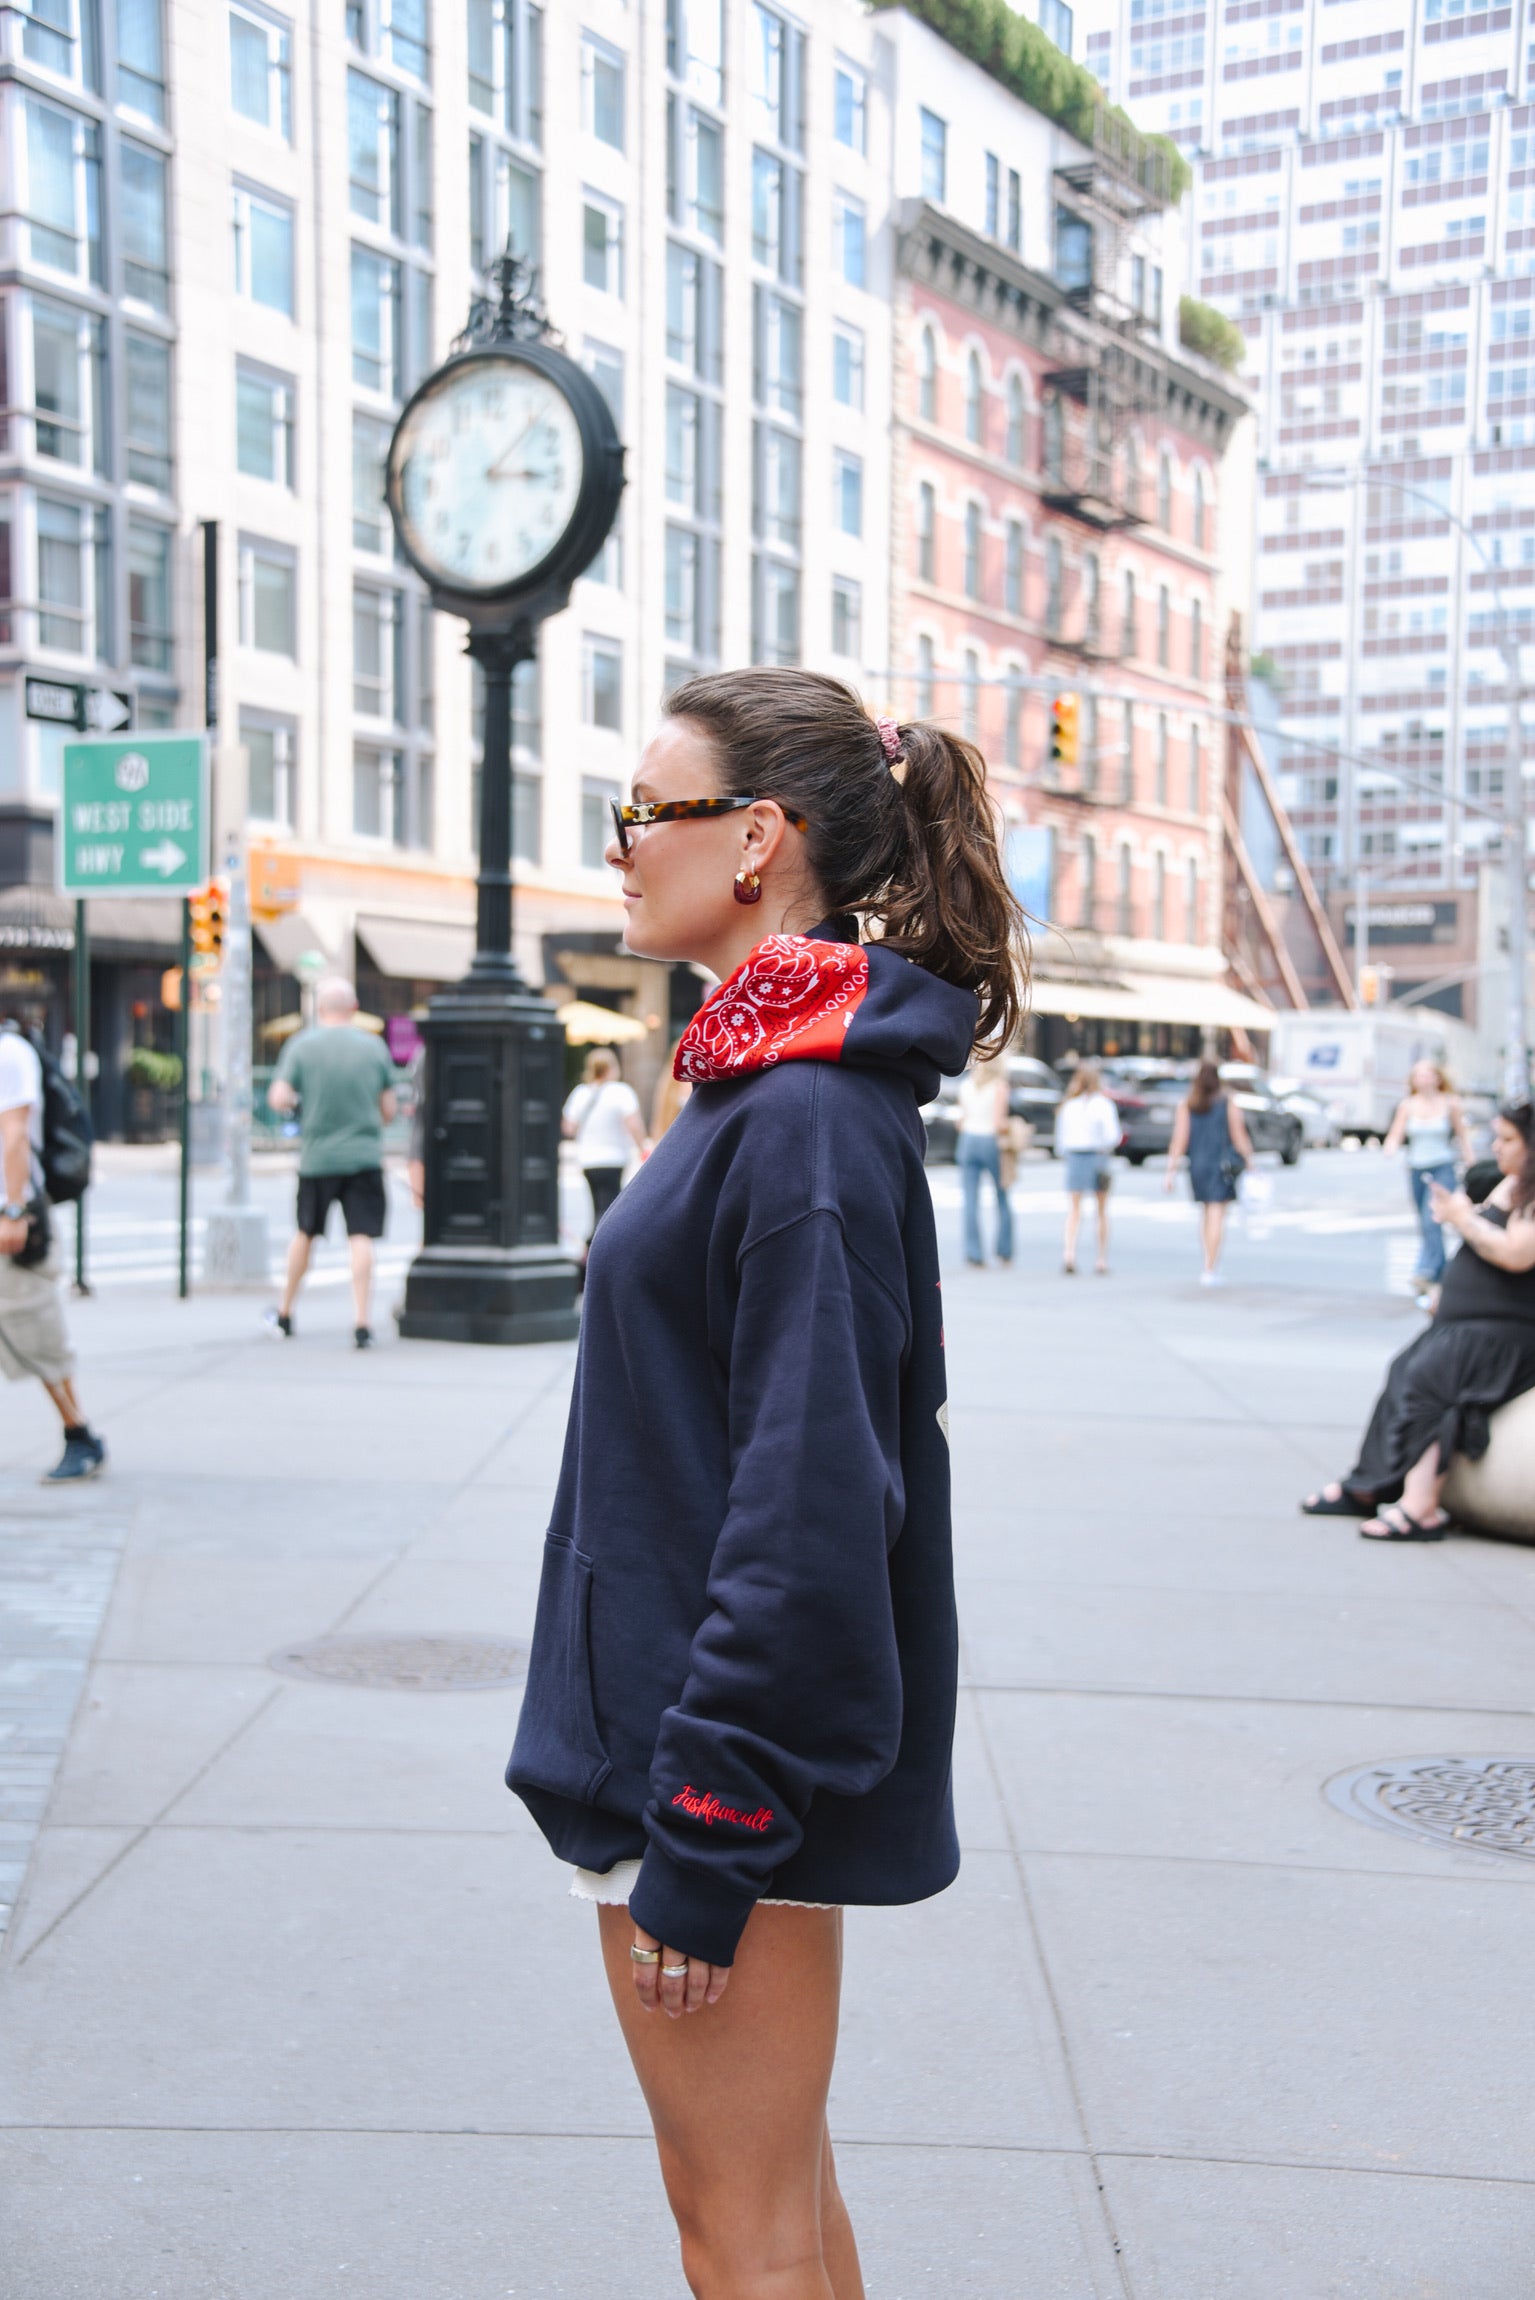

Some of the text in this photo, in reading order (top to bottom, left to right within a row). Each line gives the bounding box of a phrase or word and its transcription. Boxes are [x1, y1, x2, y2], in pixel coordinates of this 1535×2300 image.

[73, 799, 193, 834] WEST SIDE
[75, 843, 124, 875] HWY
